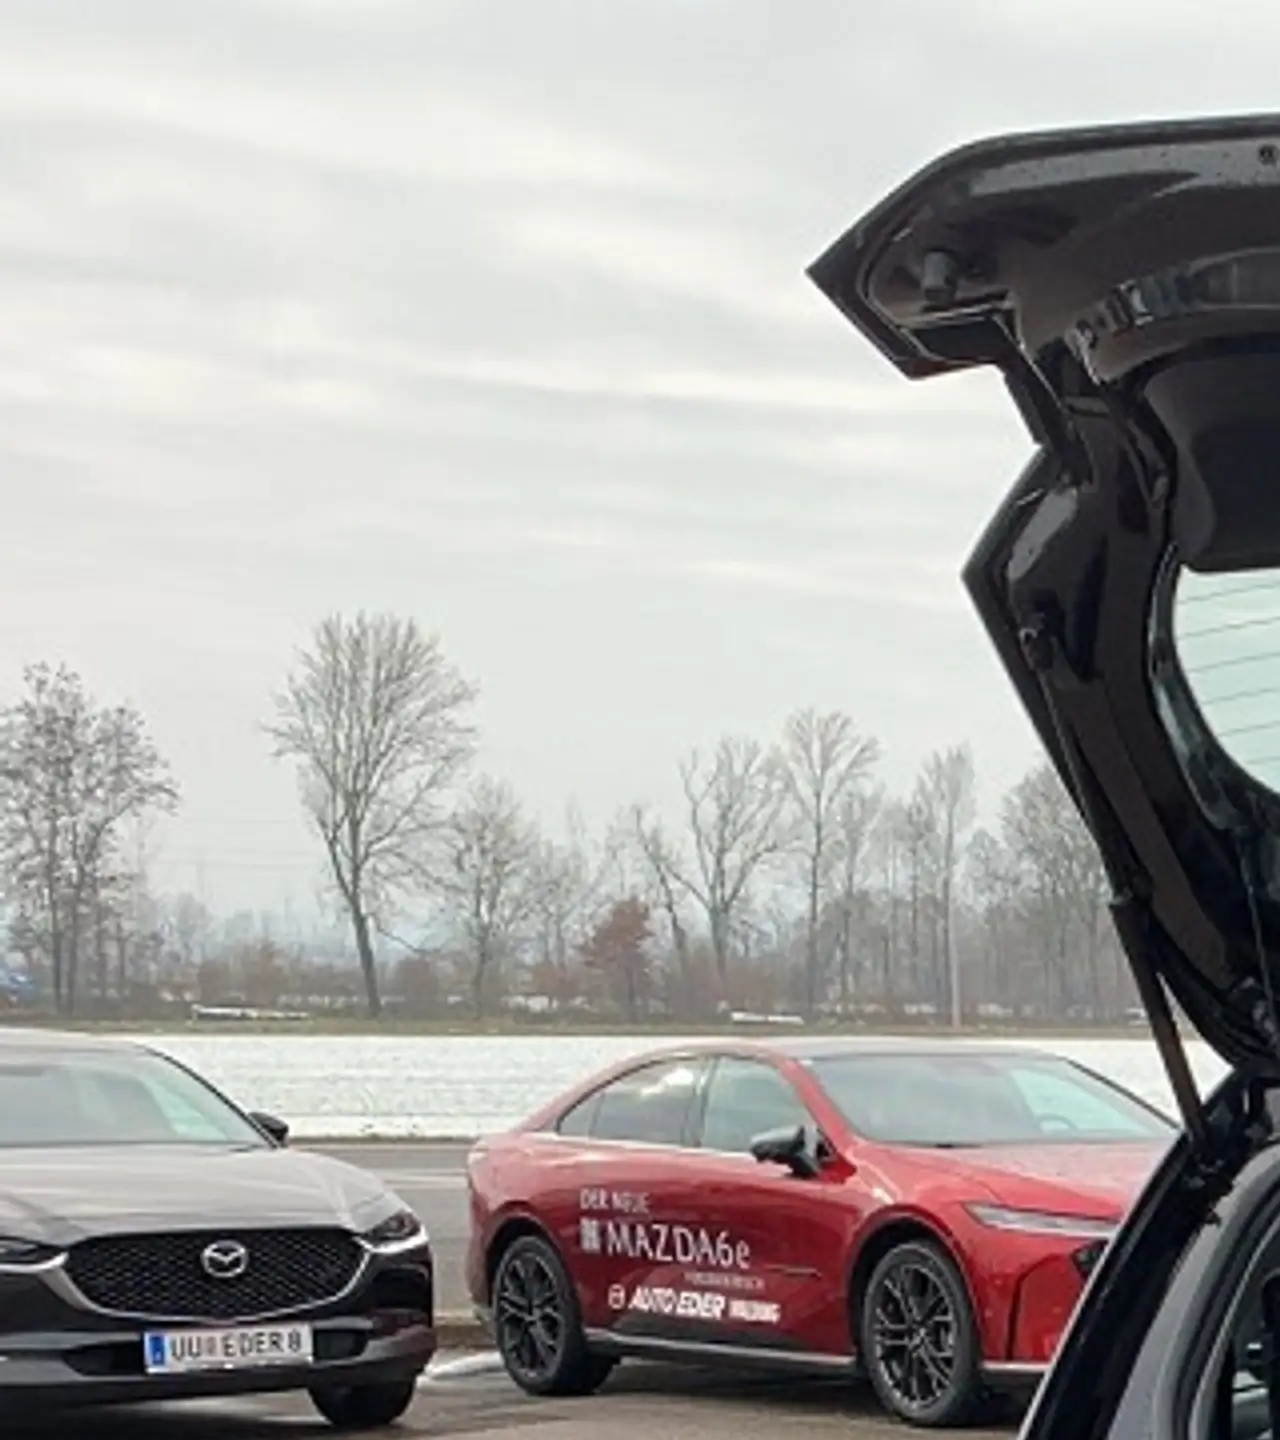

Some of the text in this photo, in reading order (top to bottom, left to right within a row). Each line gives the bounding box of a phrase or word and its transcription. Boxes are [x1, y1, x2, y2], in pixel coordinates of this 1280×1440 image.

[581, 1188, 608, 1210] DER
[607, 1220, 750, 1269] MAZDA6e
[628, 1286, 677, 1314] AUTO
[675, 1290, 726, 1320] EDER
[170, 1336, 200, 1361] UU
[221, 1331, 285, 1357] EDER
